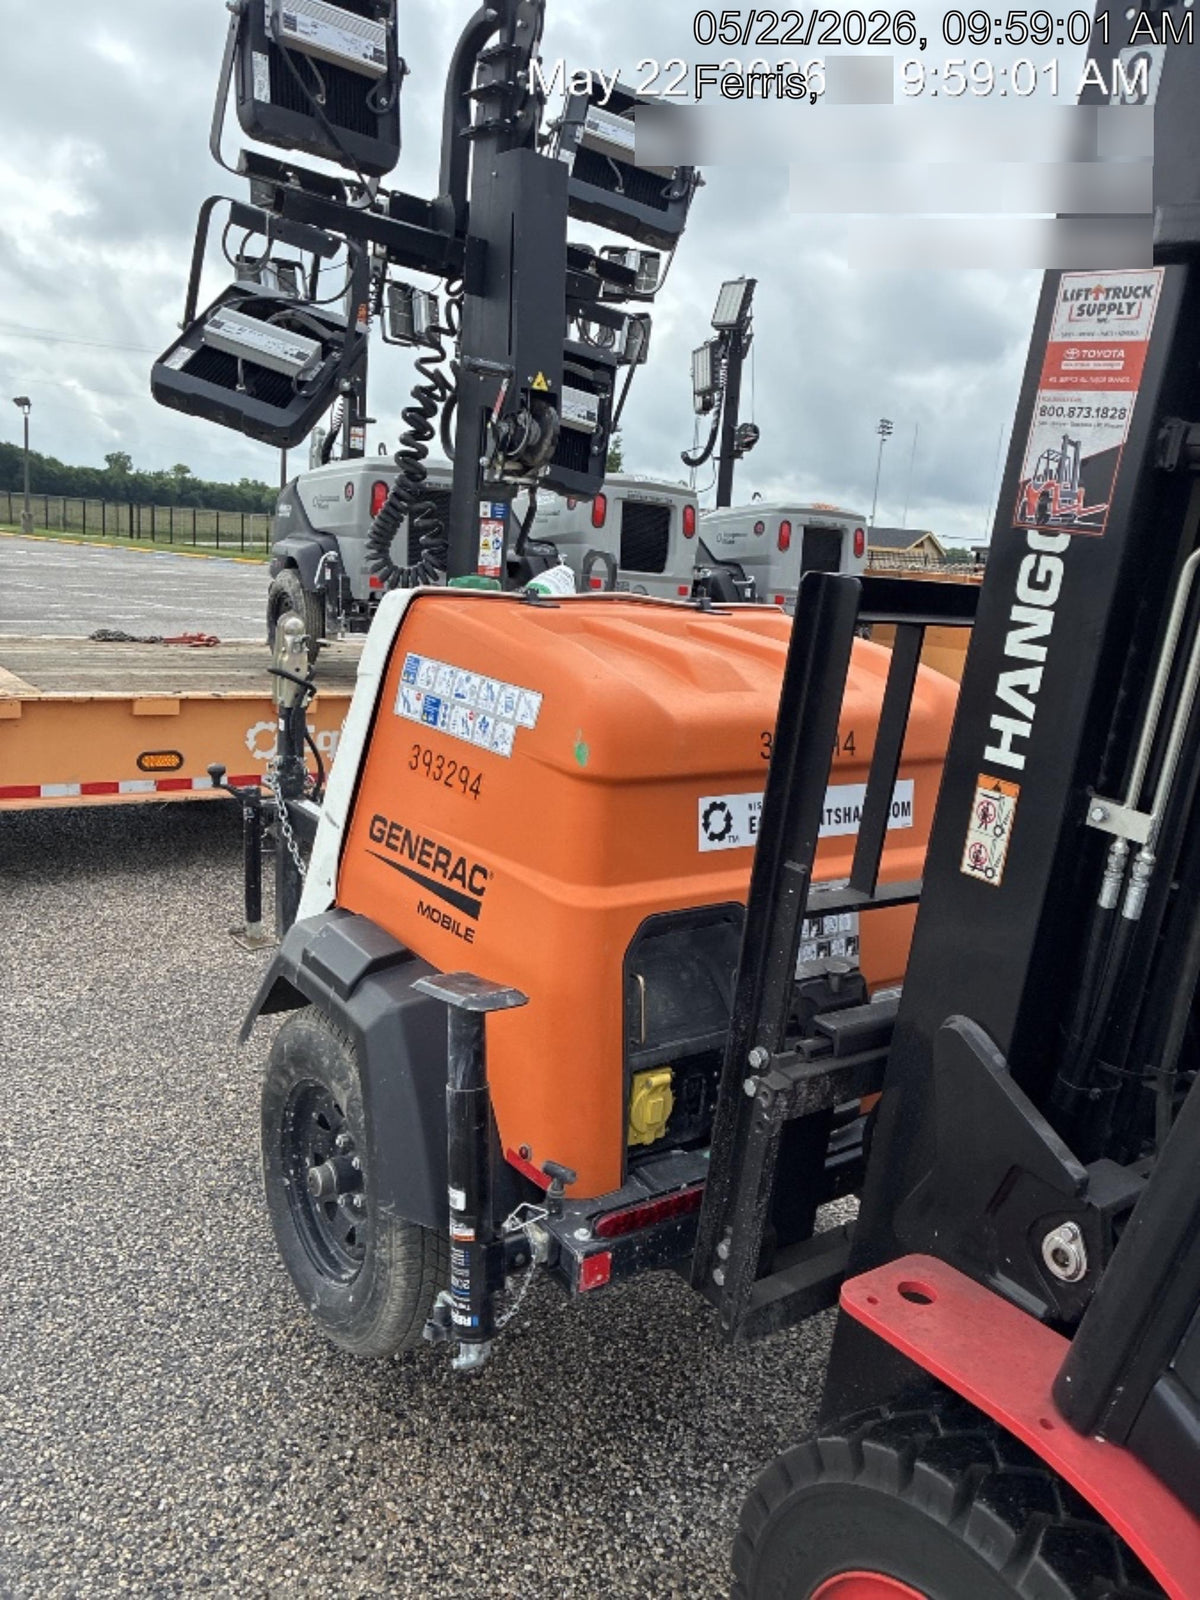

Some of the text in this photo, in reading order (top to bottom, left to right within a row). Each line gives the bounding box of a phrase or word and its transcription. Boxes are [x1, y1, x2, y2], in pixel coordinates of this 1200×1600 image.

[1061, 284, 1153, 302] LIFT TRUCK
[1076, 301, 1137, 317] SUPPLY
[1081, 349, 1126, 358] TOYOTA
[408, 744, 483, 801] 393294
[368, 813, 488, 897] GENERAC
[416, 899, 476, 944] MOBILE
